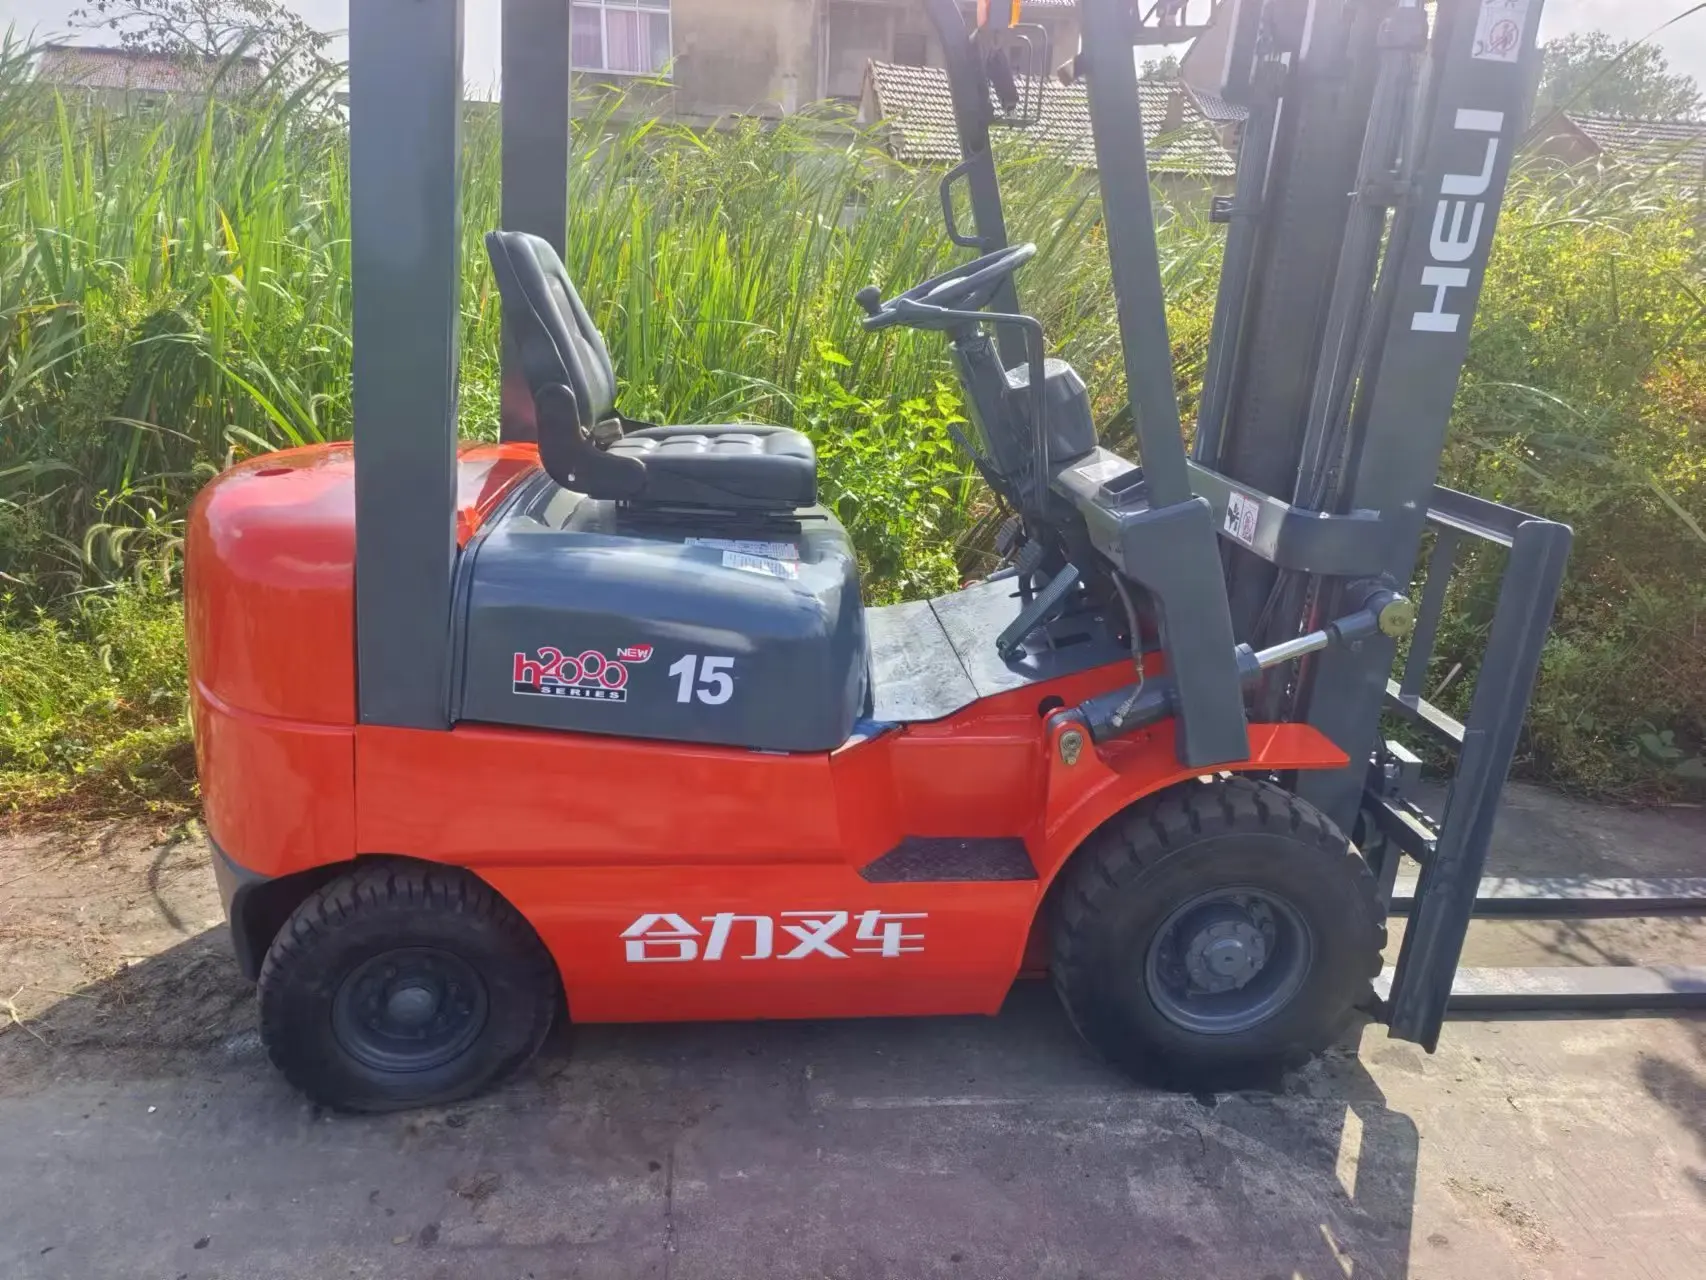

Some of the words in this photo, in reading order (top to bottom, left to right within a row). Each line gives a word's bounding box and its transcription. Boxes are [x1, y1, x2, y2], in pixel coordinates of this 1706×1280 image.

[1410, 108, 1504, 333] HELI
[616, 647, 649, 659] NEW
[540, 685, 620, 700] SERIES
[668, 654, 735, 705] 15
[619, 910, 929, 963] 合力叉车
